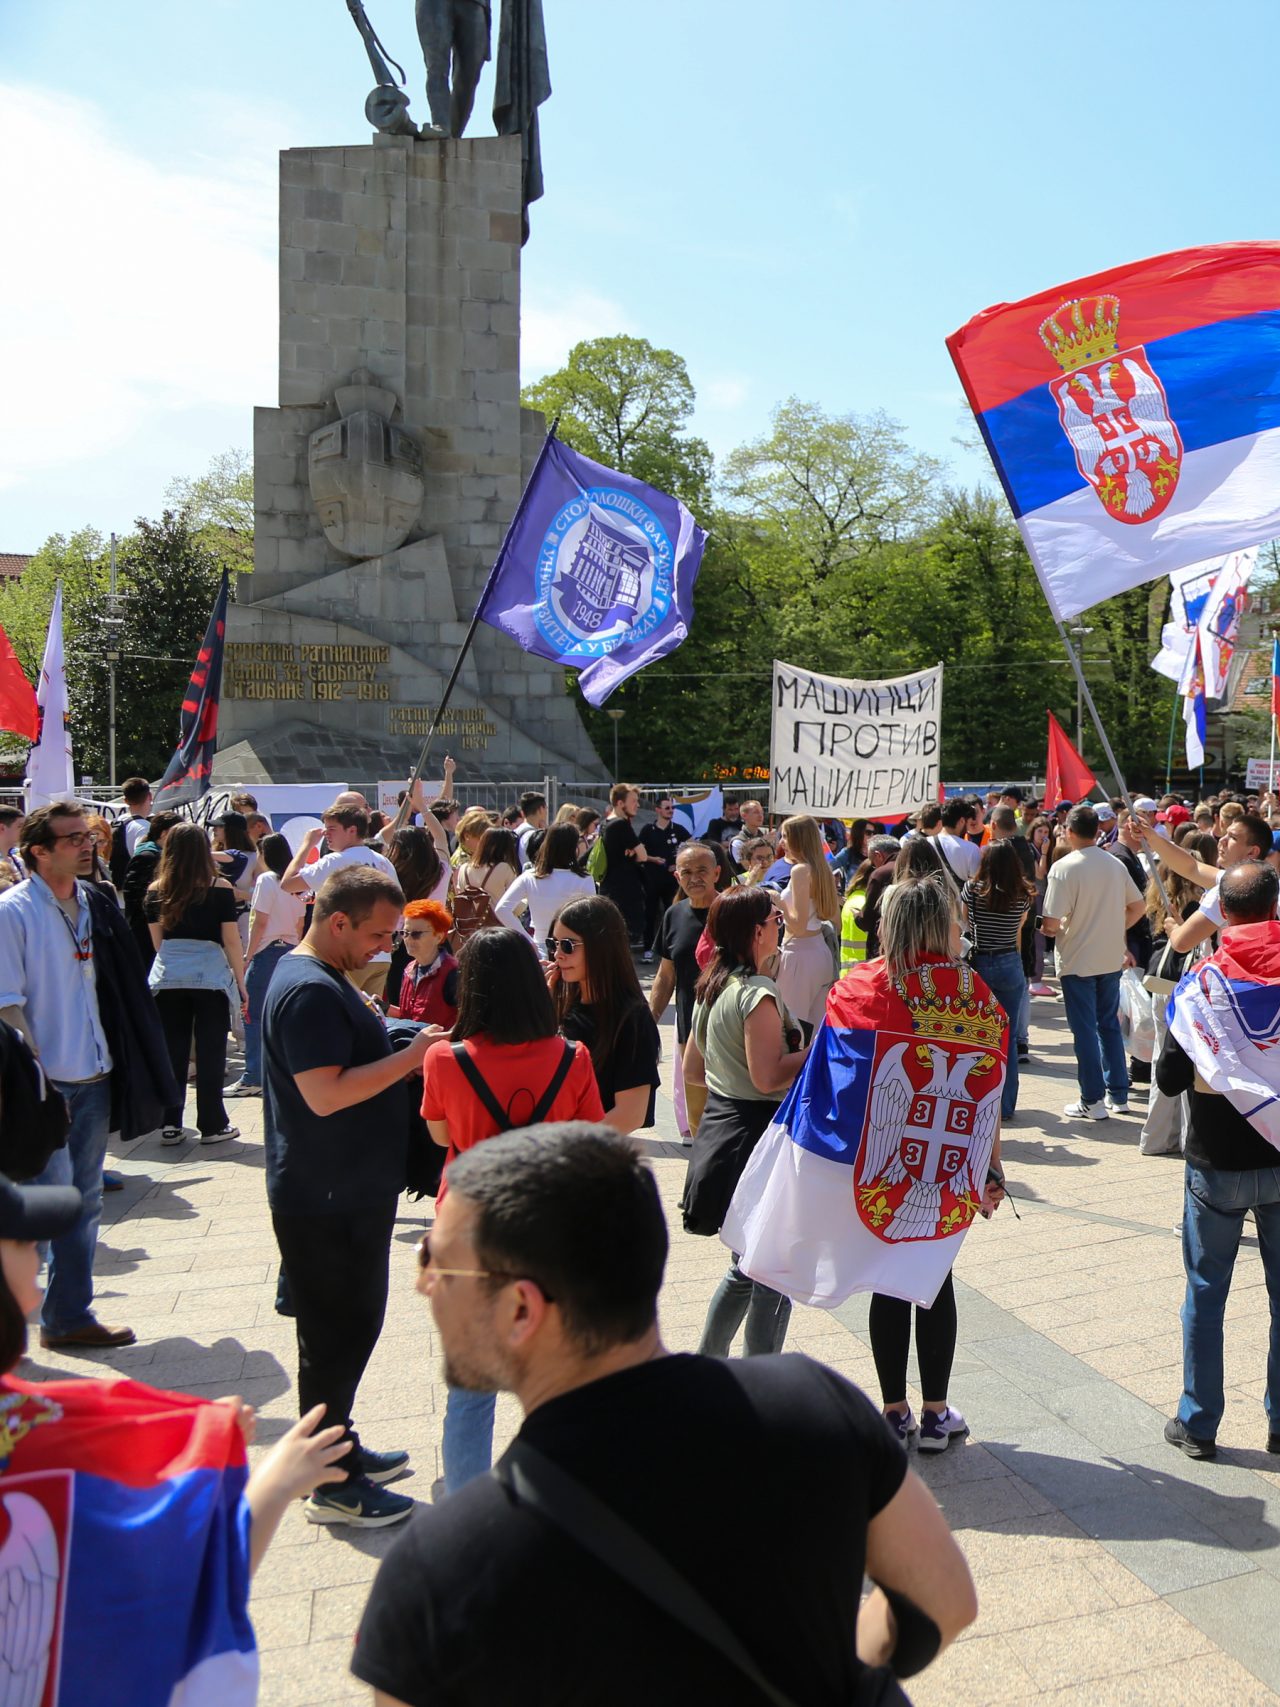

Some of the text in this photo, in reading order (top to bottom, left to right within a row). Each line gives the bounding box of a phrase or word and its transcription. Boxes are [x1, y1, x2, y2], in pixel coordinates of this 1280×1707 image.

[555, 492, 648, 531] СТОМОЛОШКИ
[573, 600, 603, 629] 1948
[601, 612, 657, 654] БЕГРАДУ
[283, 663, 302, 681] ЗА
[307, 663, 377, 682] СЛОБОДУ
[300, 645, 390, 664] РАТНИЦИМА
[777, 674, 936, 716] МАШИНЦИ
[401, 722, 457, 737] ЗАХВЛНИ
[793, 720, 937, 759] ПРОТИВ
[774, 763, 938, 809] МАШИНЕРИЈЕ
